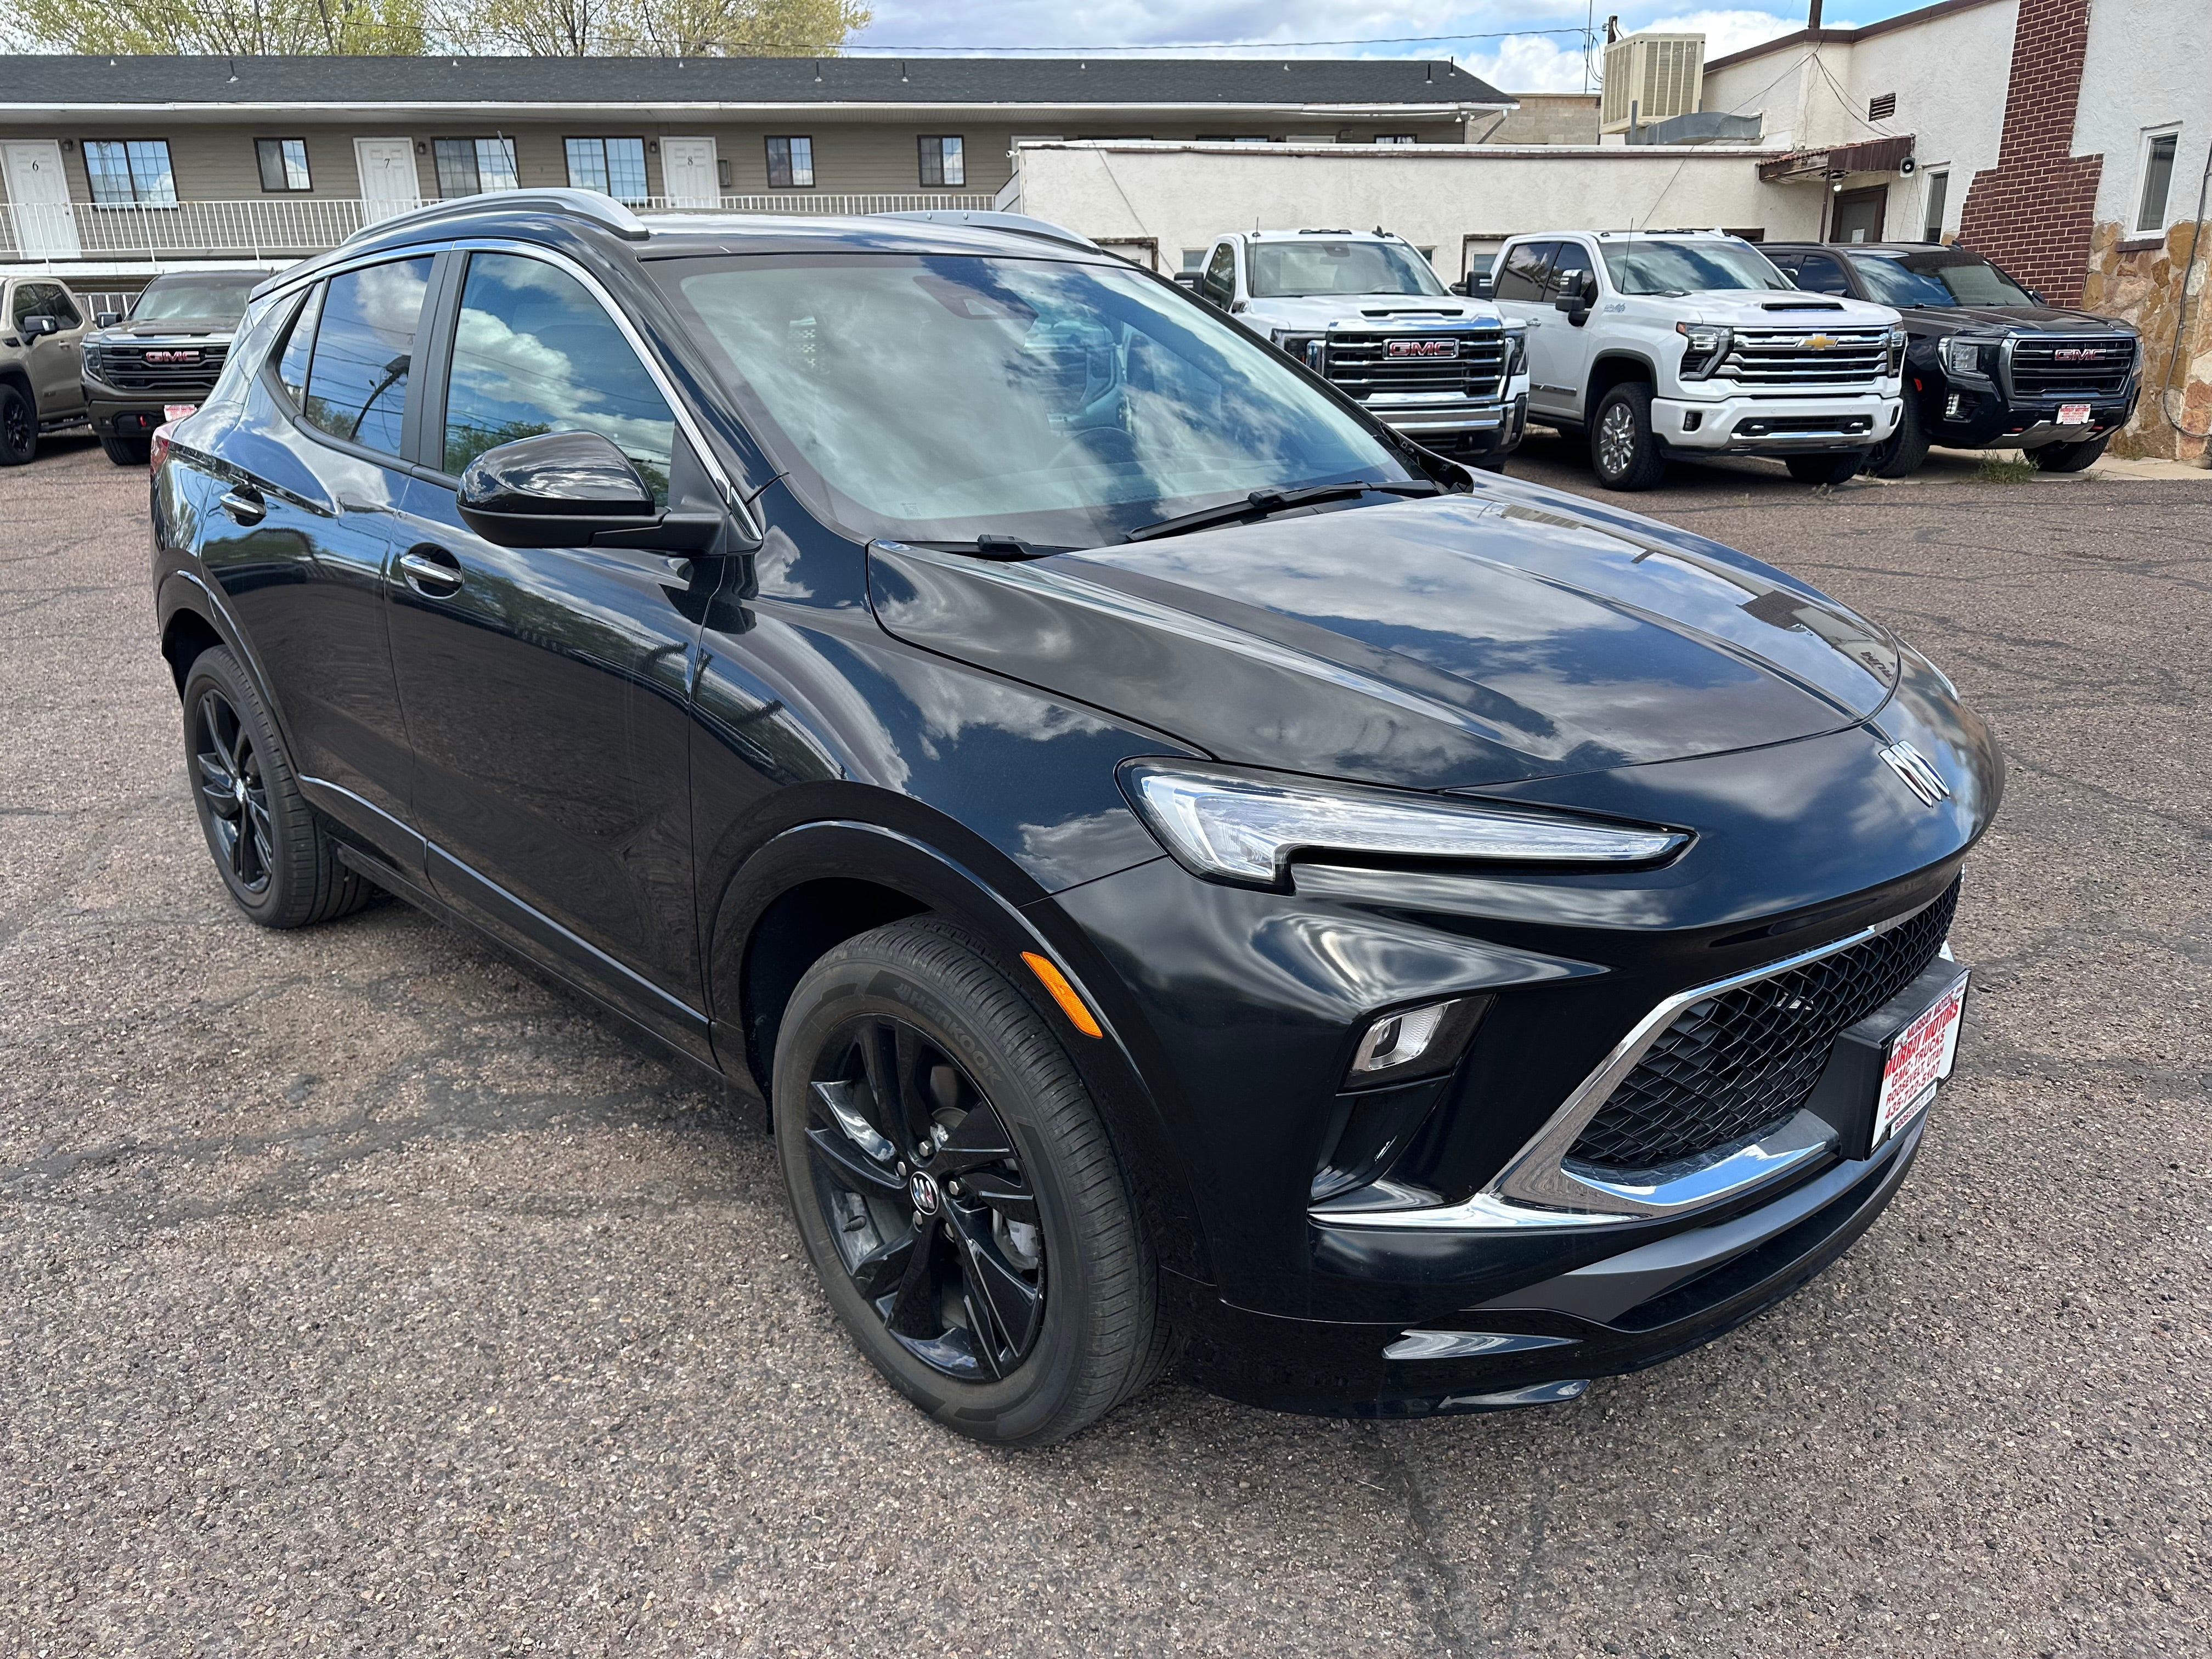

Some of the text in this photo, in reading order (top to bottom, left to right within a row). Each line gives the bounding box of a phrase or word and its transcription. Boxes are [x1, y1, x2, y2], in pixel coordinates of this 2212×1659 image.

[32, 160, 39, 171] 6
[384, 158, 390, 168] 7
[687, 156, 693, 166] 8
[146, 351, 200, 362] GMC
[1389, 341, 1454, 356] GMC
[2055, 348, 2107, 361] GMC
[1906, 1008, 1934, 1040] MURRAY
[909, 990, 1003, 1086] Hankook
[1883, 998, 1959, 1080] MURRAY MOTORS
[1915, 1029, 1945, 1066] TRUCKS
[1886, 1042, 1945, 1106] ROOSEVELT, UTAH
[1884, 1059, 1941, 1120] 435-722-5107
